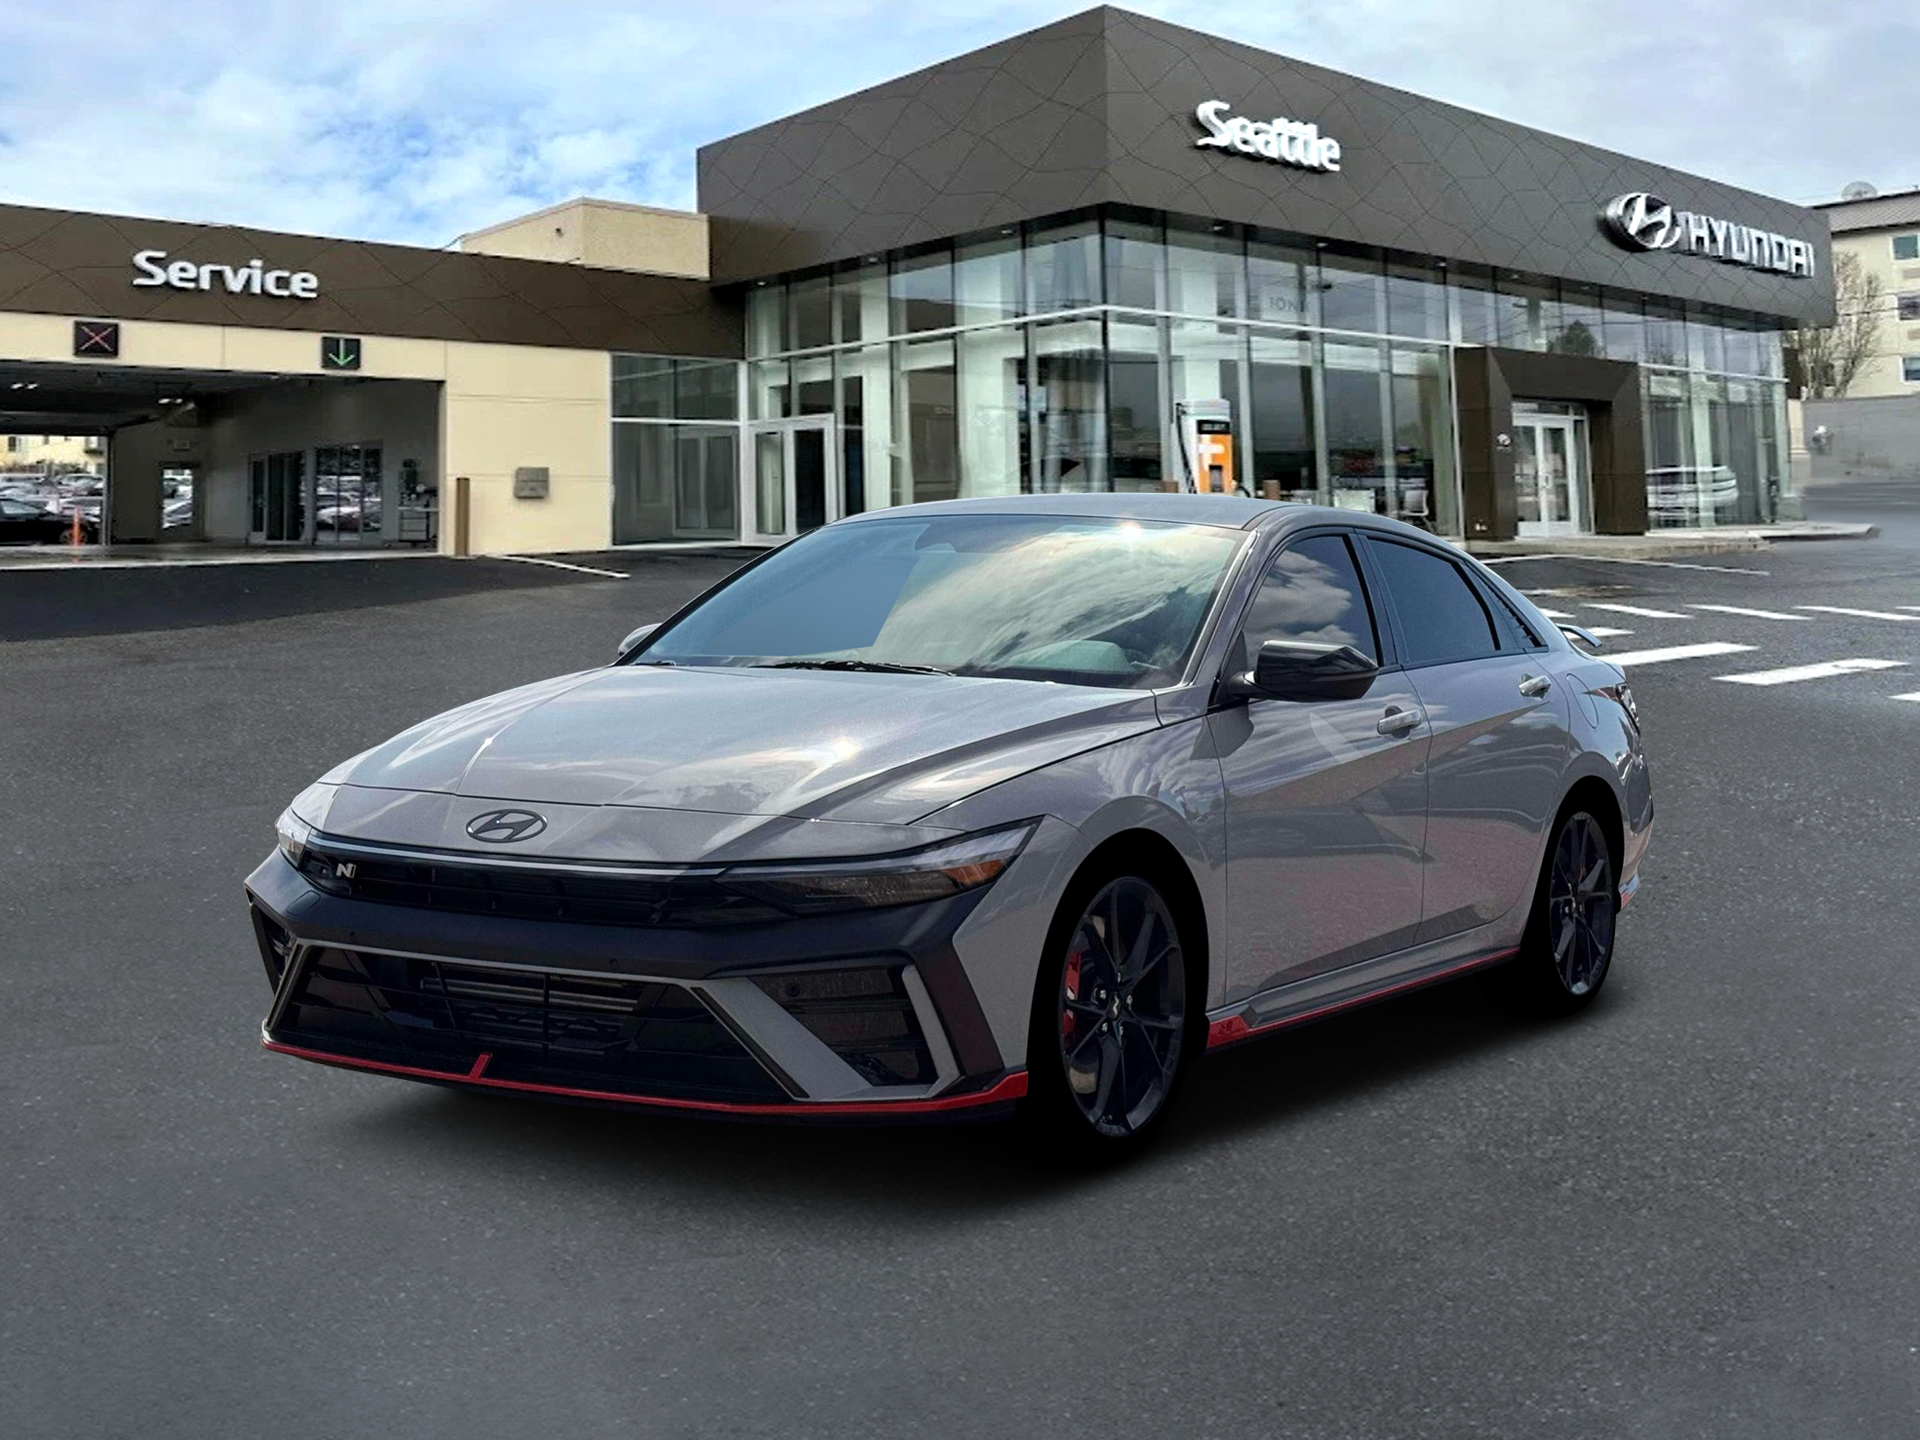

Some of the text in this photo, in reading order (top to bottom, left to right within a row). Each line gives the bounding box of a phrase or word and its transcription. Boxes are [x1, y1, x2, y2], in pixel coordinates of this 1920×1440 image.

[1196, 100, 1340, 171] Seattle
[133, 250, 318, 298] Service
[1679, 211, 1814, 278] HYUNDAI
